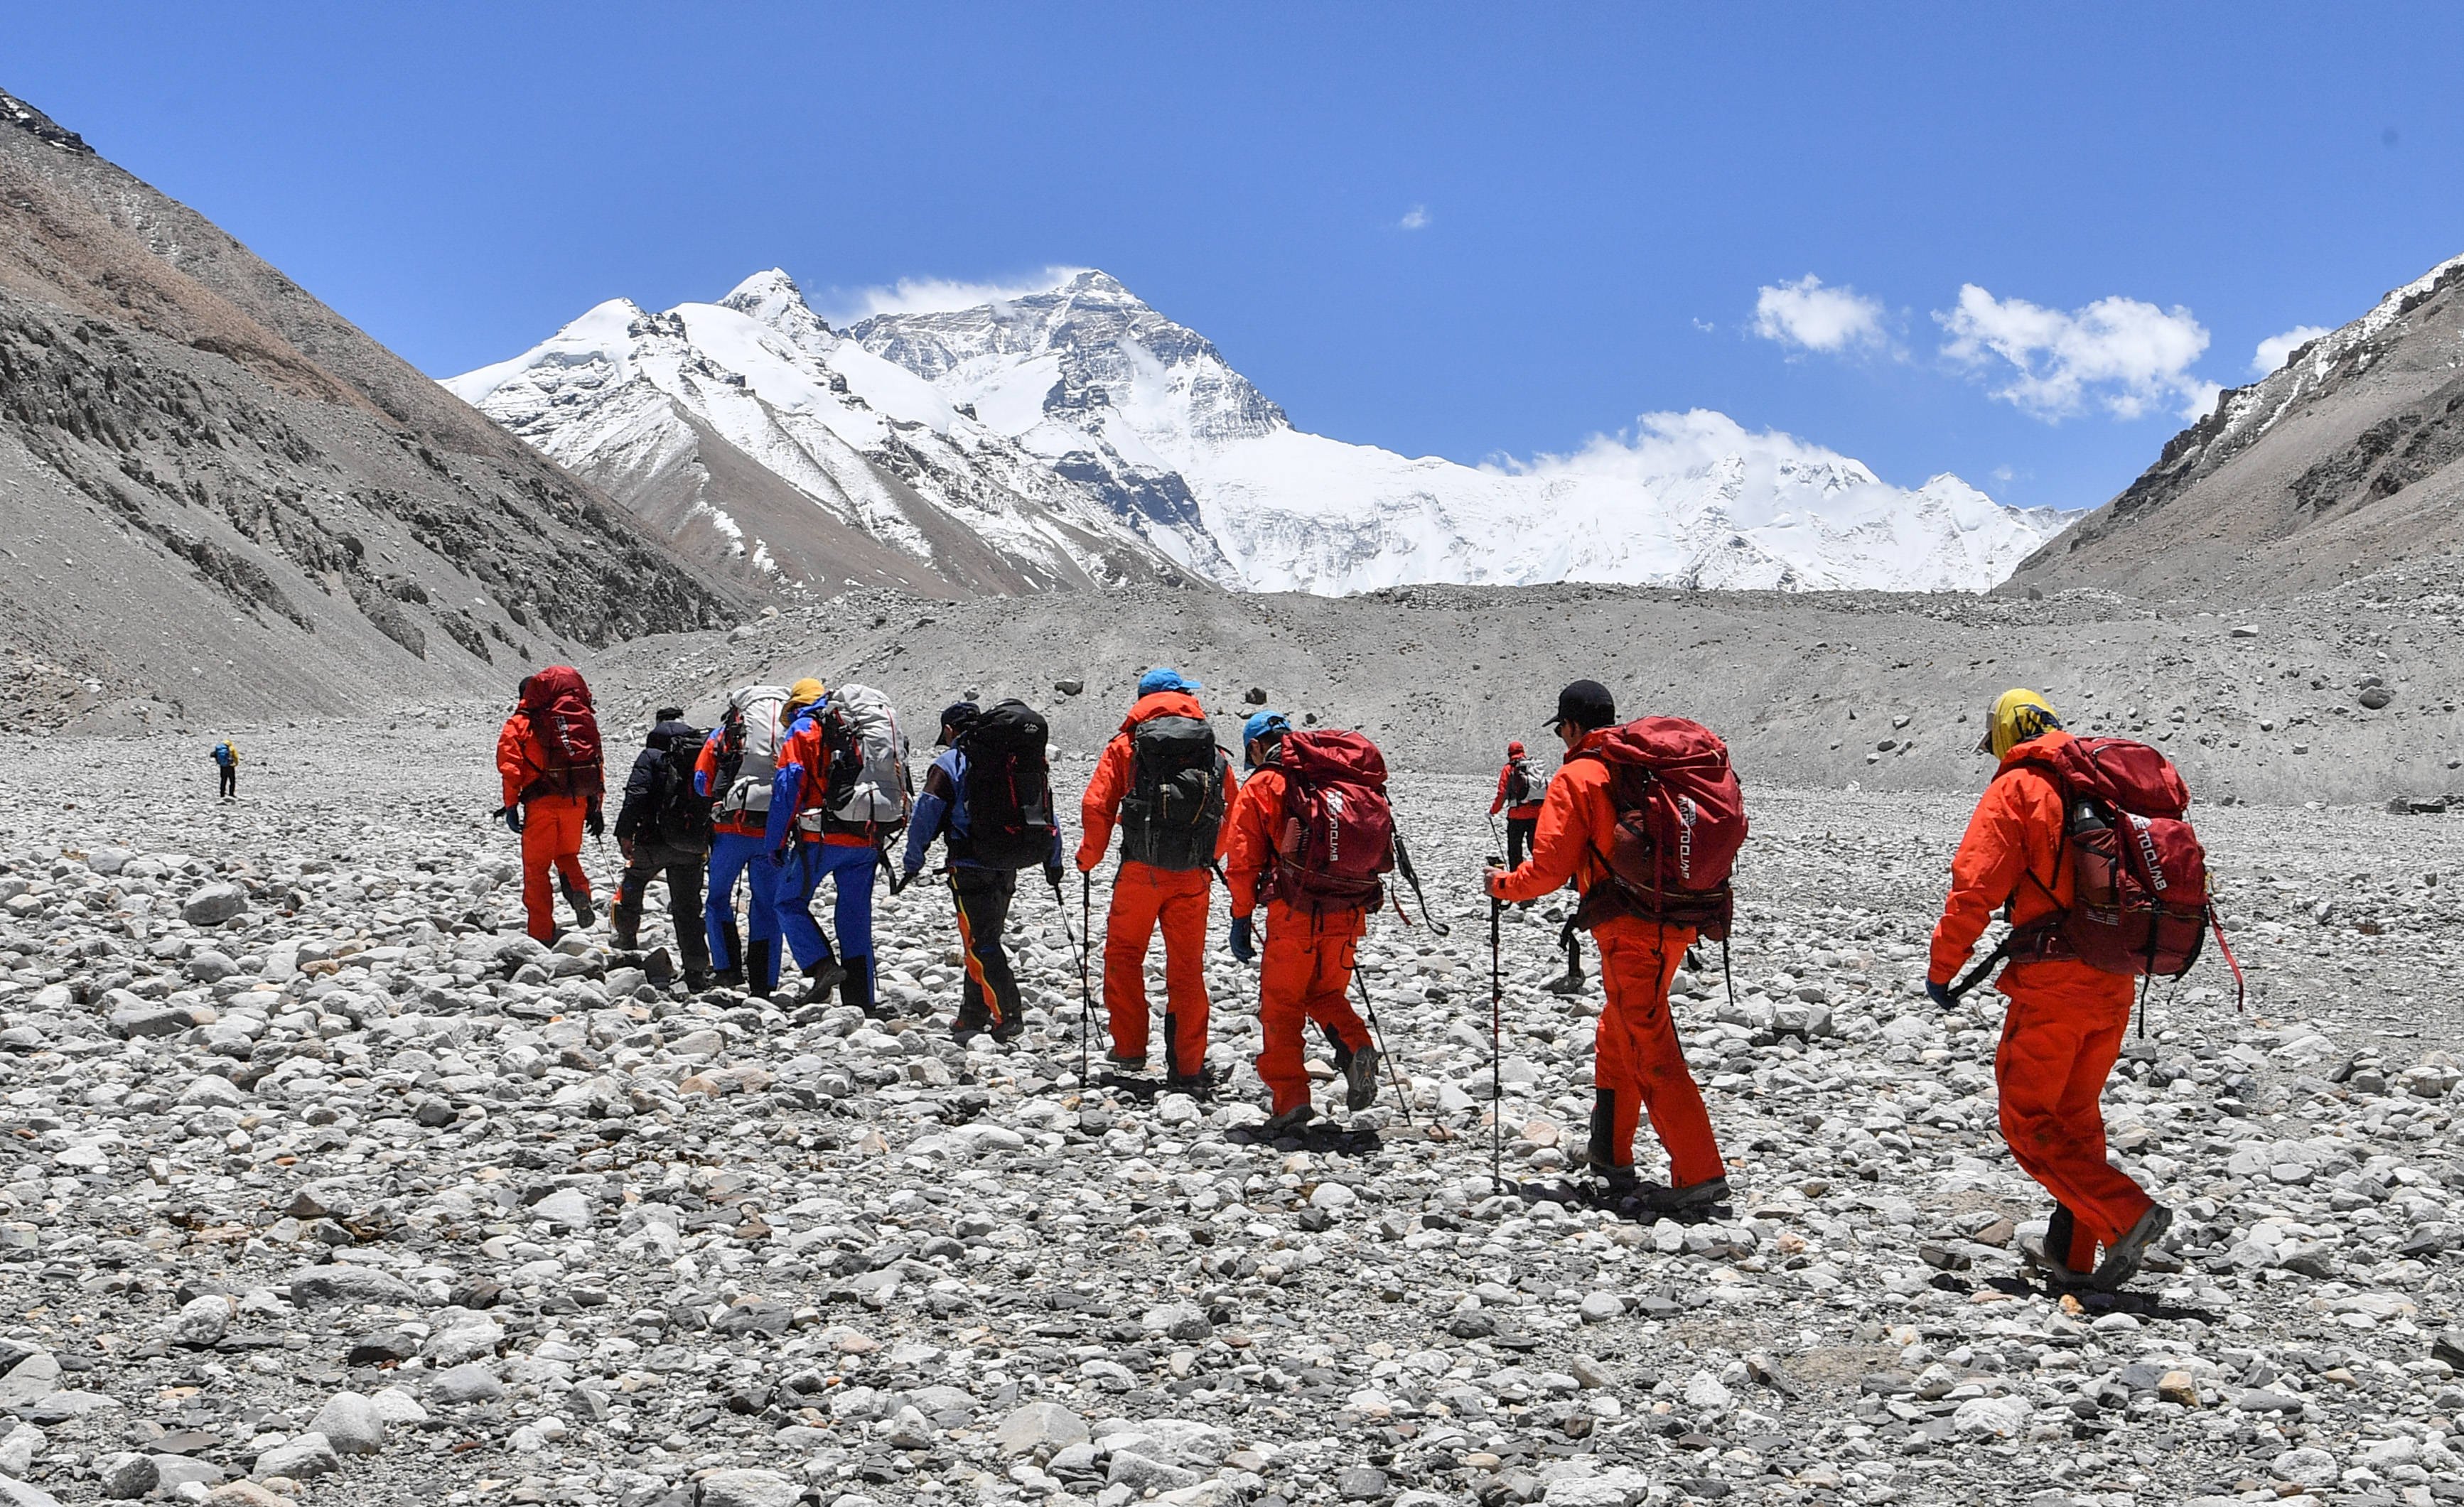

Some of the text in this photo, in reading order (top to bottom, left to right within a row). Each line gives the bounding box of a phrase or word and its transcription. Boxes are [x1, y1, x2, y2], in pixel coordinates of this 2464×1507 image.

[1330, 830, 1338, 861] CLIMB
[2137, 831, 2153, 850] TO
[1679, 845, 1690, 878] CLIMB
[2143, 849, 2167, 891] CLIMB
